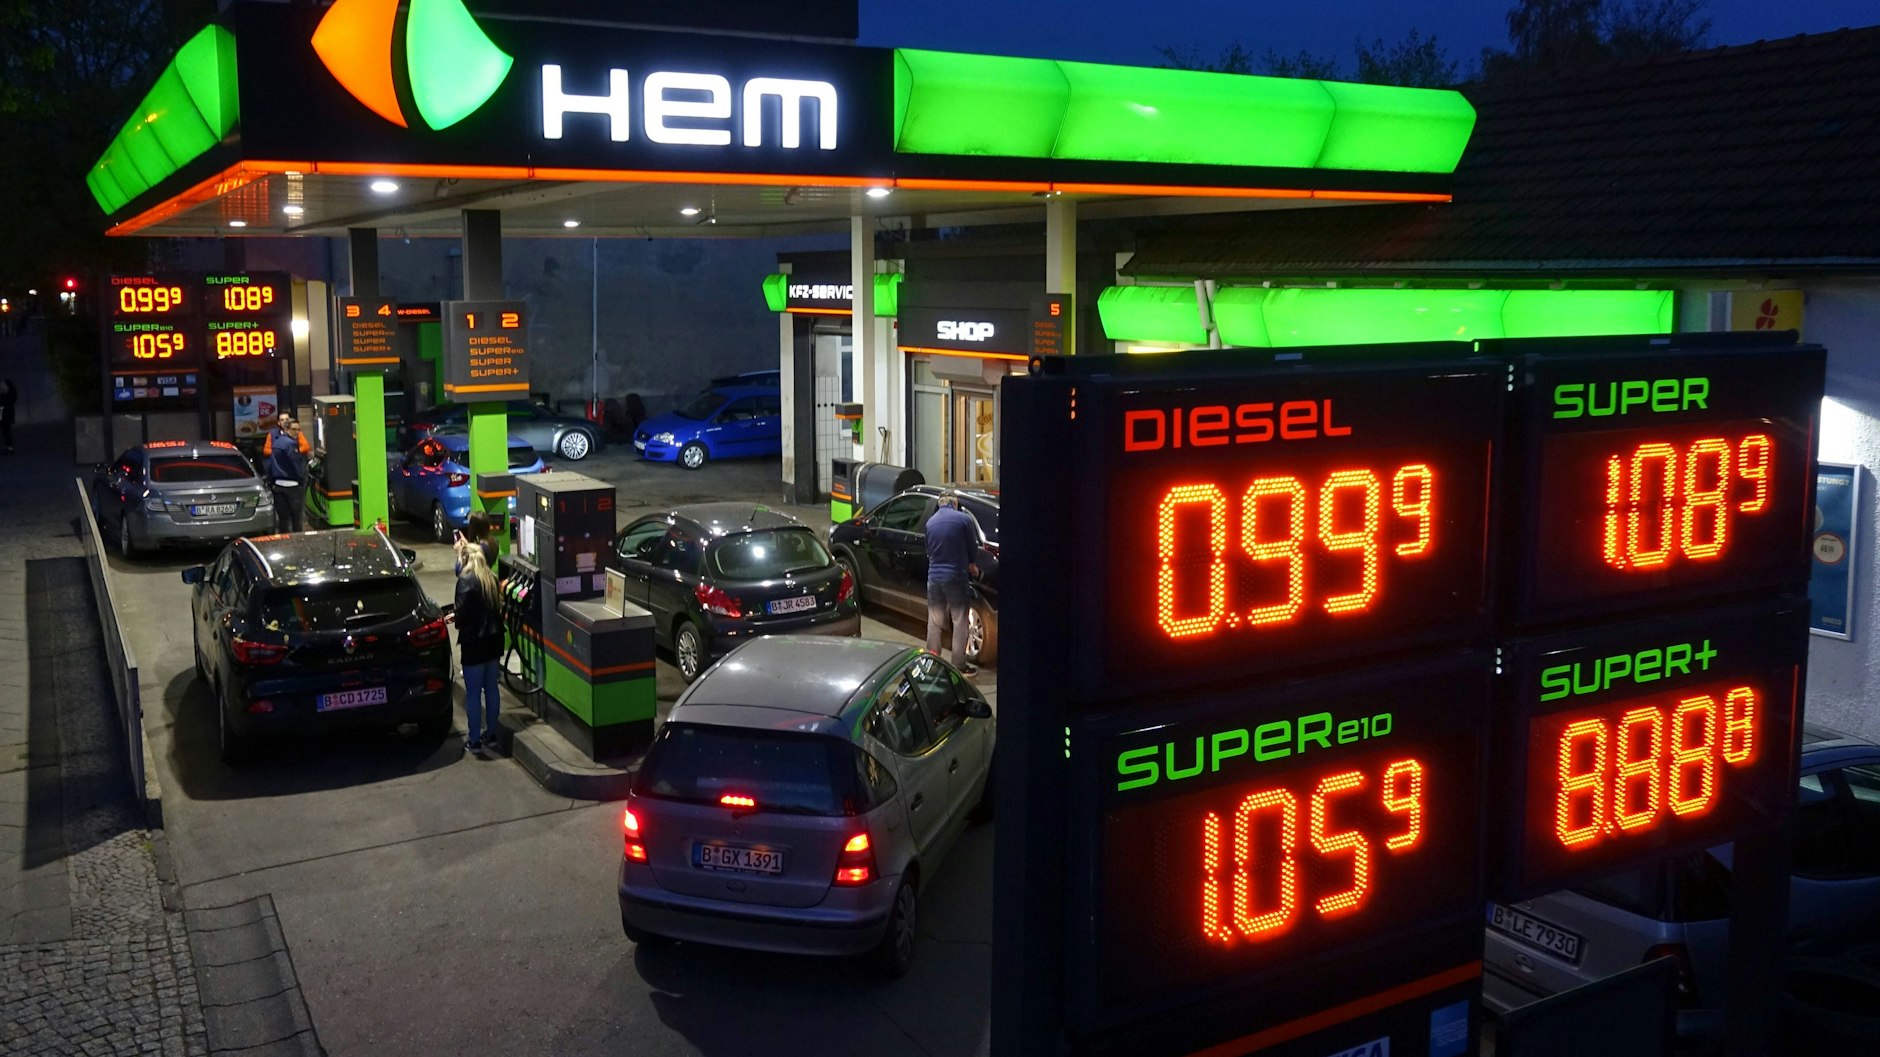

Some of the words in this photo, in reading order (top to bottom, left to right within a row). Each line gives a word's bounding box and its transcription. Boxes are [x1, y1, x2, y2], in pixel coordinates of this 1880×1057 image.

[111, 277, 158, 285] DIESEL
[346, 305, 360, 317] 3
[378, 304, 391, 316] 4
[1050, 303, 1060, 316] 5
[208, 321, 259, 330] SUPER+
[466, 314, 474, 329] 1
[502, 313, 519, 328] 2
[937, 320, 995, 341] SHOP
[469, 336, 512, 345] DIESEL
[470, 357, 512, 366] SUPER
[470, 367, 519, 377] SUPER+
[1553, 377, 1709, 419] SUPER
[1125, 400, 1352, 452] DIESEL
[1540, 639, 1718, 702] SUPER+
[324, 695, 332, 707] B
[339, 693, 355, 705] CD
[357, 689, 385, 703] 1725
[702, 847, 712, 862] B
[722, 849, 740, 865] GX
[744, 852, 780, 870] 1391
[1494, 907, 1503, 925] B
[1512, 915, 1533, 938] LE
[1536, 924, 1575, 955] 7930
